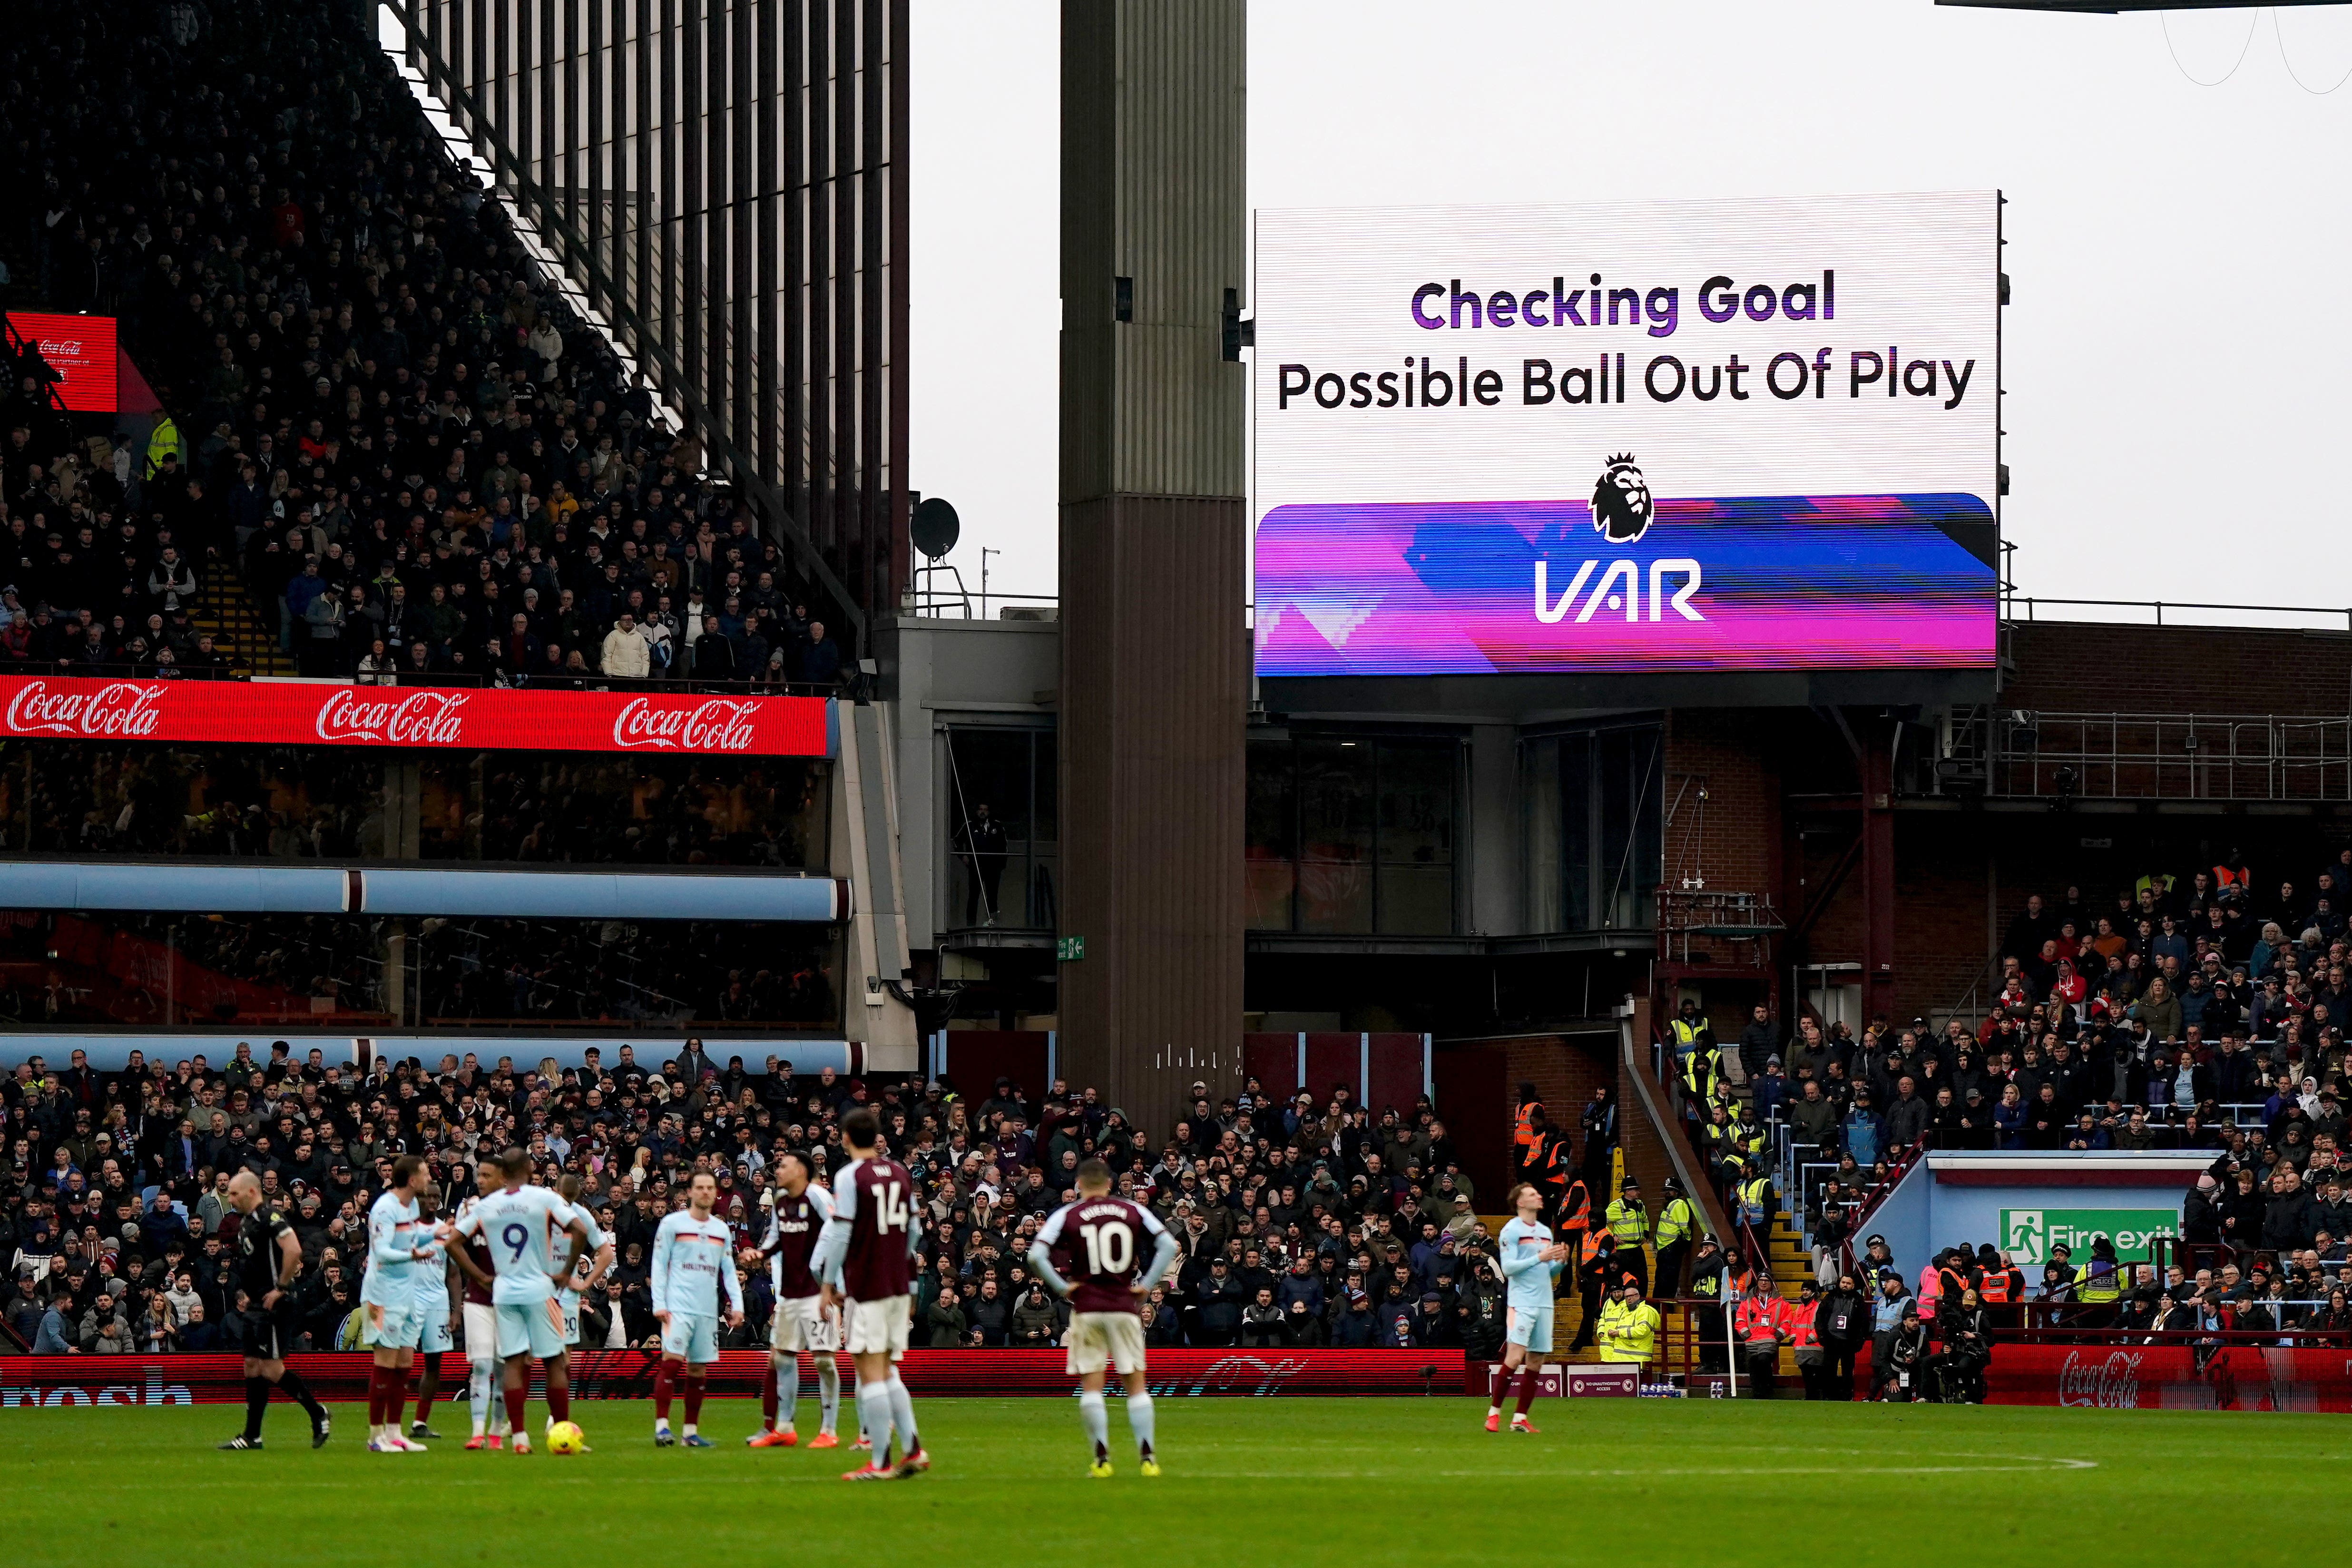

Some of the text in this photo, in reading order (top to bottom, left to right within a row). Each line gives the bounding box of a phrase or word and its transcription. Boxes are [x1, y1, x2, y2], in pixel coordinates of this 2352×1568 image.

[1411, 269, 1834, 337] Checking Goal
[1279, 346, 1975, 410] Possible Ball Out Of Play
[1535, 559, 1707, 623] VAR
[7, 681, 169, 735] Coca-Cola
[316, 690, 471, 743] Coca-Cola
[614, 697, 763, 750] Coca-Cola
[871, 1181, 907, 1235] 14
[503, 1224, 529, 1264] 9
[1079, 1221, 1133, 1275] 10
[2116, 1225, 2174, 1250] exit
